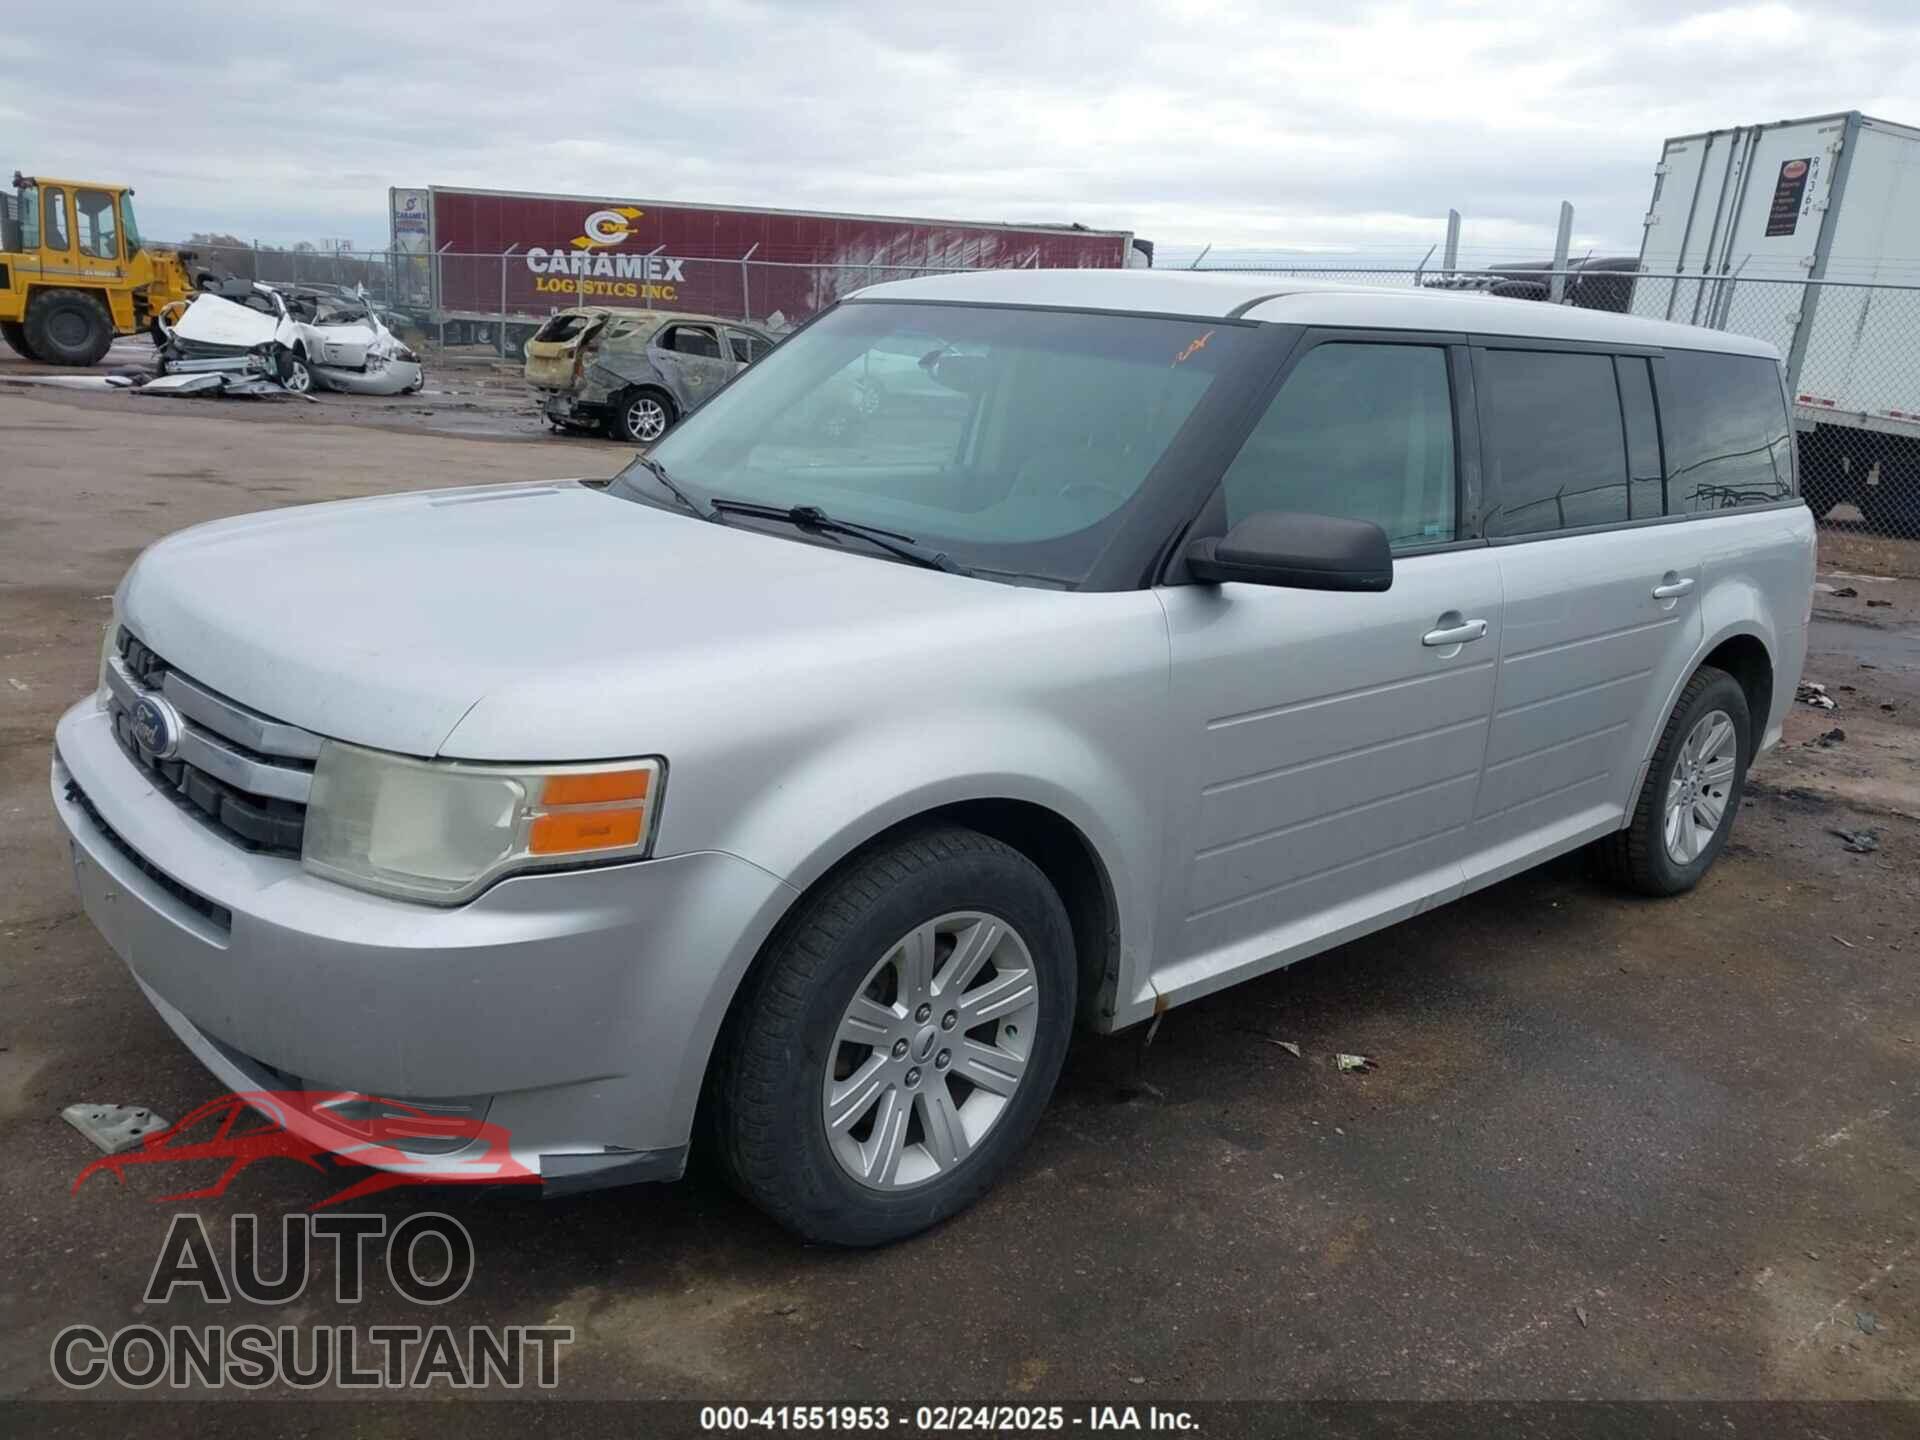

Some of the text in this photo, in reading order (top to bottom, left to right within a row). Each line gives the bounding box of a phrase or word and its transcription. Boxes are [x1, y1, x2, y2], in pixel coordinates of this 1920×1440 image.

[526, 247, 686, 282] CARAMEX
[536, 277, 679, 300] LOGISTICS INC.
